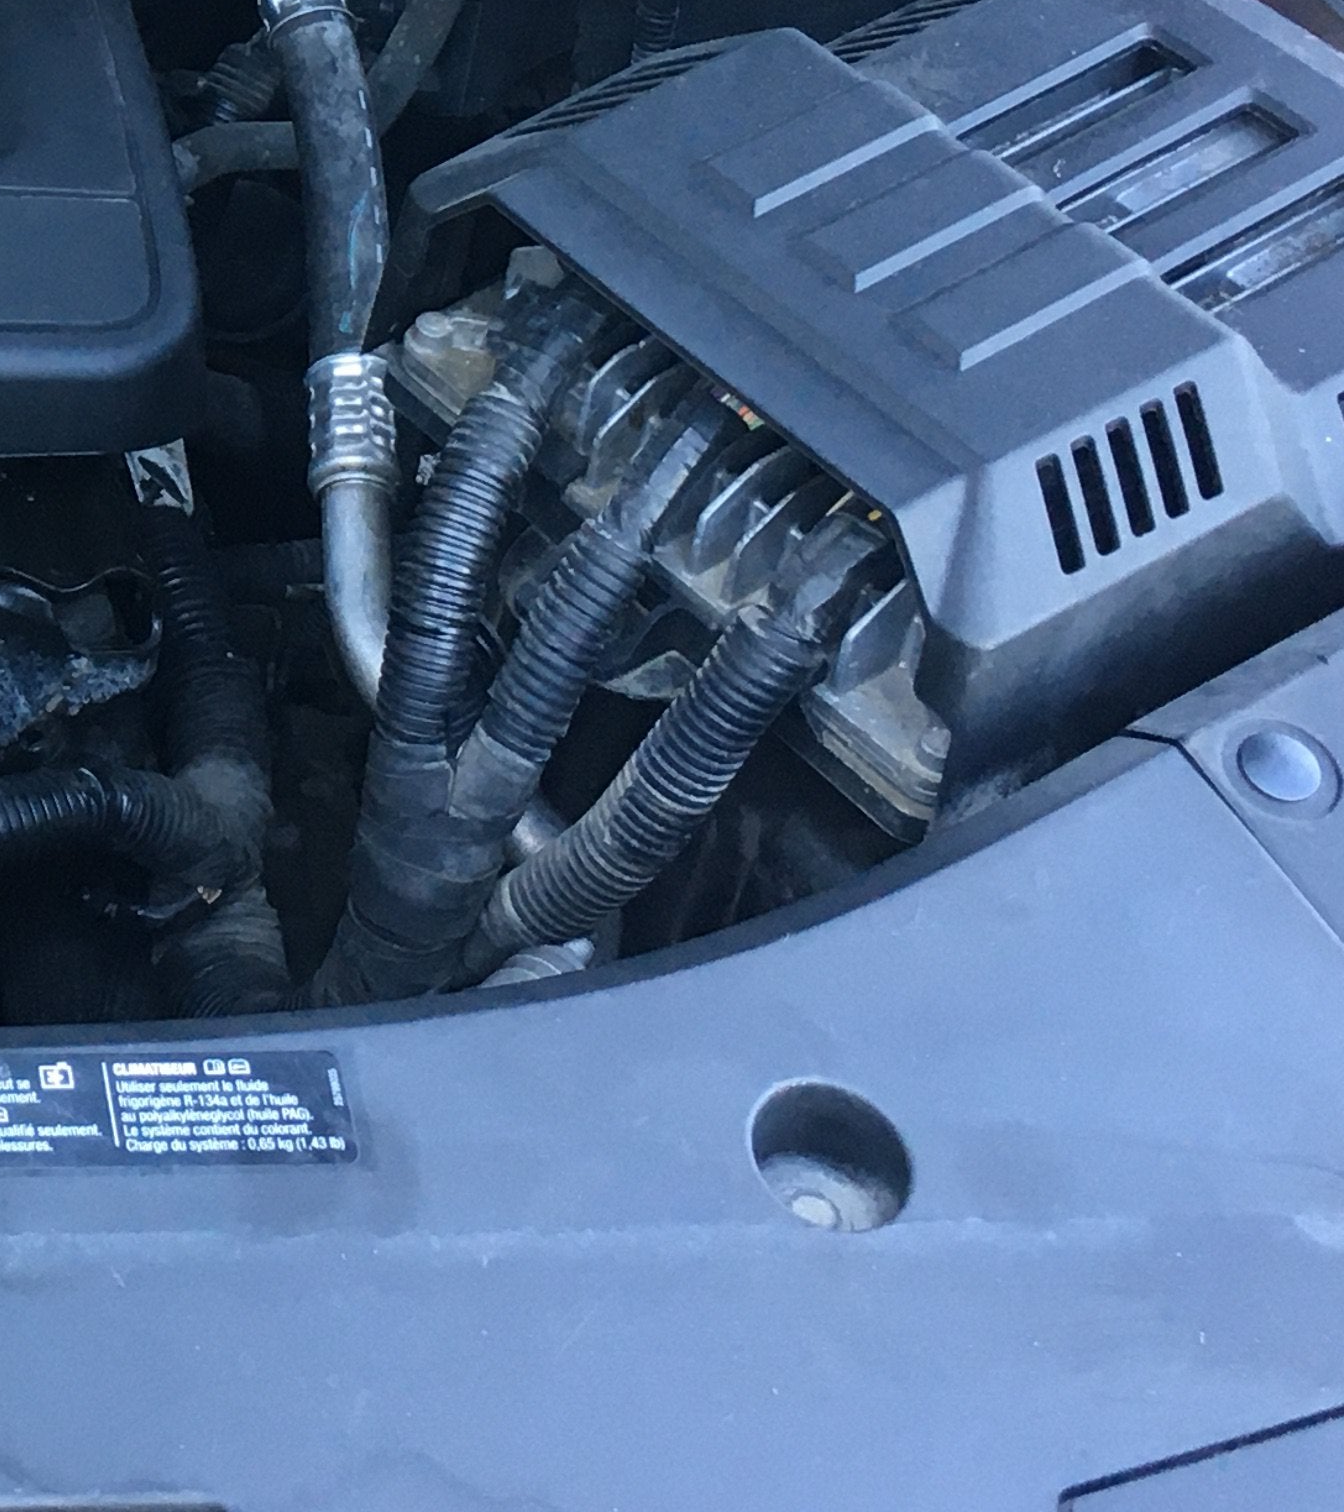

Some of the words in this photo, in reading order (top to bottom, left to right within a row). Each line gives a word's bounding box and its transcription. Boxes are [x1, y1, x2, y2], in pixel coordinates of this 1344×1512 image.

[112, 1062, 198, 1076] CLIMATISEUR
[17, 1079, 31, 1090] se
[115, 1081, 156, 1094] Utiliser
[158, 1080, 220, 1093] seulement
[222, 1080, 233, 1092] le
[236, 1079, 269, 1092] fluide
[118, 1094, 181, 1109] frigorigène
[183, 1094, 228, 1107] R-134a
[230, 1094, 243, 1106] et
[245, 1093, 261, 1106] de
[263, 1093, 299, 1106] l'huile
[120, 1110, 137, 1123] au
[247, 1108, 280, 1123] (huile
[282, 1107, 314, 1122] PAG).
[37, 1123, 102, 1137] seulement.
[123, 1124, 139, 1137] Le
[141, 1123, 191, 1139] système
[192, 1123, 241, 1136] contient
[243, 1123, 259, 1136] du
[261, 1122, 312, 1135] colorant.
[125, 1138, 168, 1154] Charge
[170, 1138, 187, 1152] du
[188, 1137, 239, 1153] système
[247, 1137, 275, 1152] 0,65
[277, 1137, 294, 1153] kg
[329, 1136, 346, 1151] lb)
